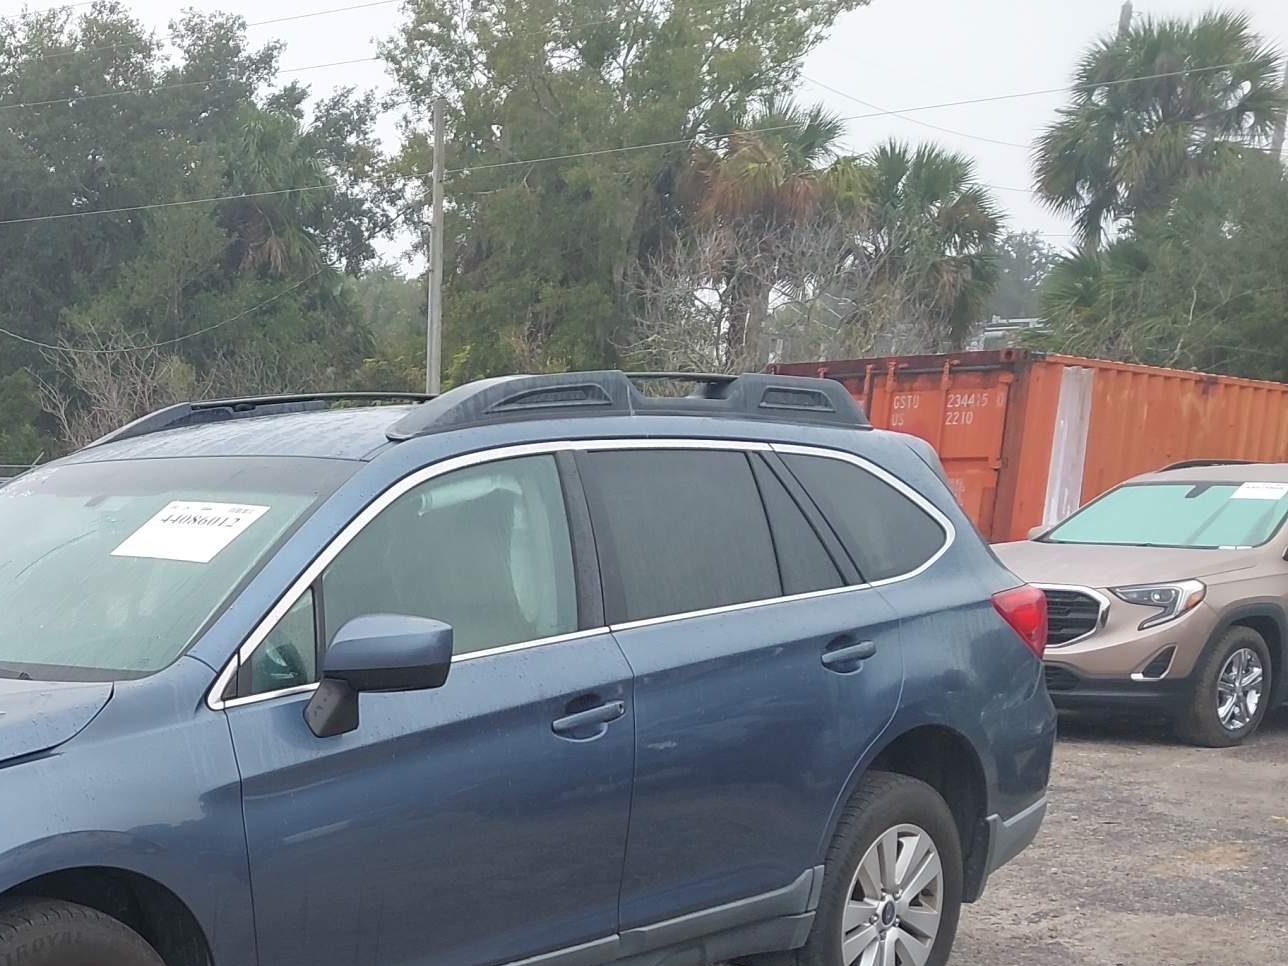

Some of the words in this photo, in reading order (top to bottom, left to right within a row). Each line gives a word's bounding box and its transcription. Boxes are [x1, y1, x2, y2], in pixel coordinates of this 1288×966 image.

[893, 395, 920, 409] GSTU
[891, 413, 905, 426] US
[945, 411, 974, 425] 2210
[161, 514, 241, 527] 44086012
